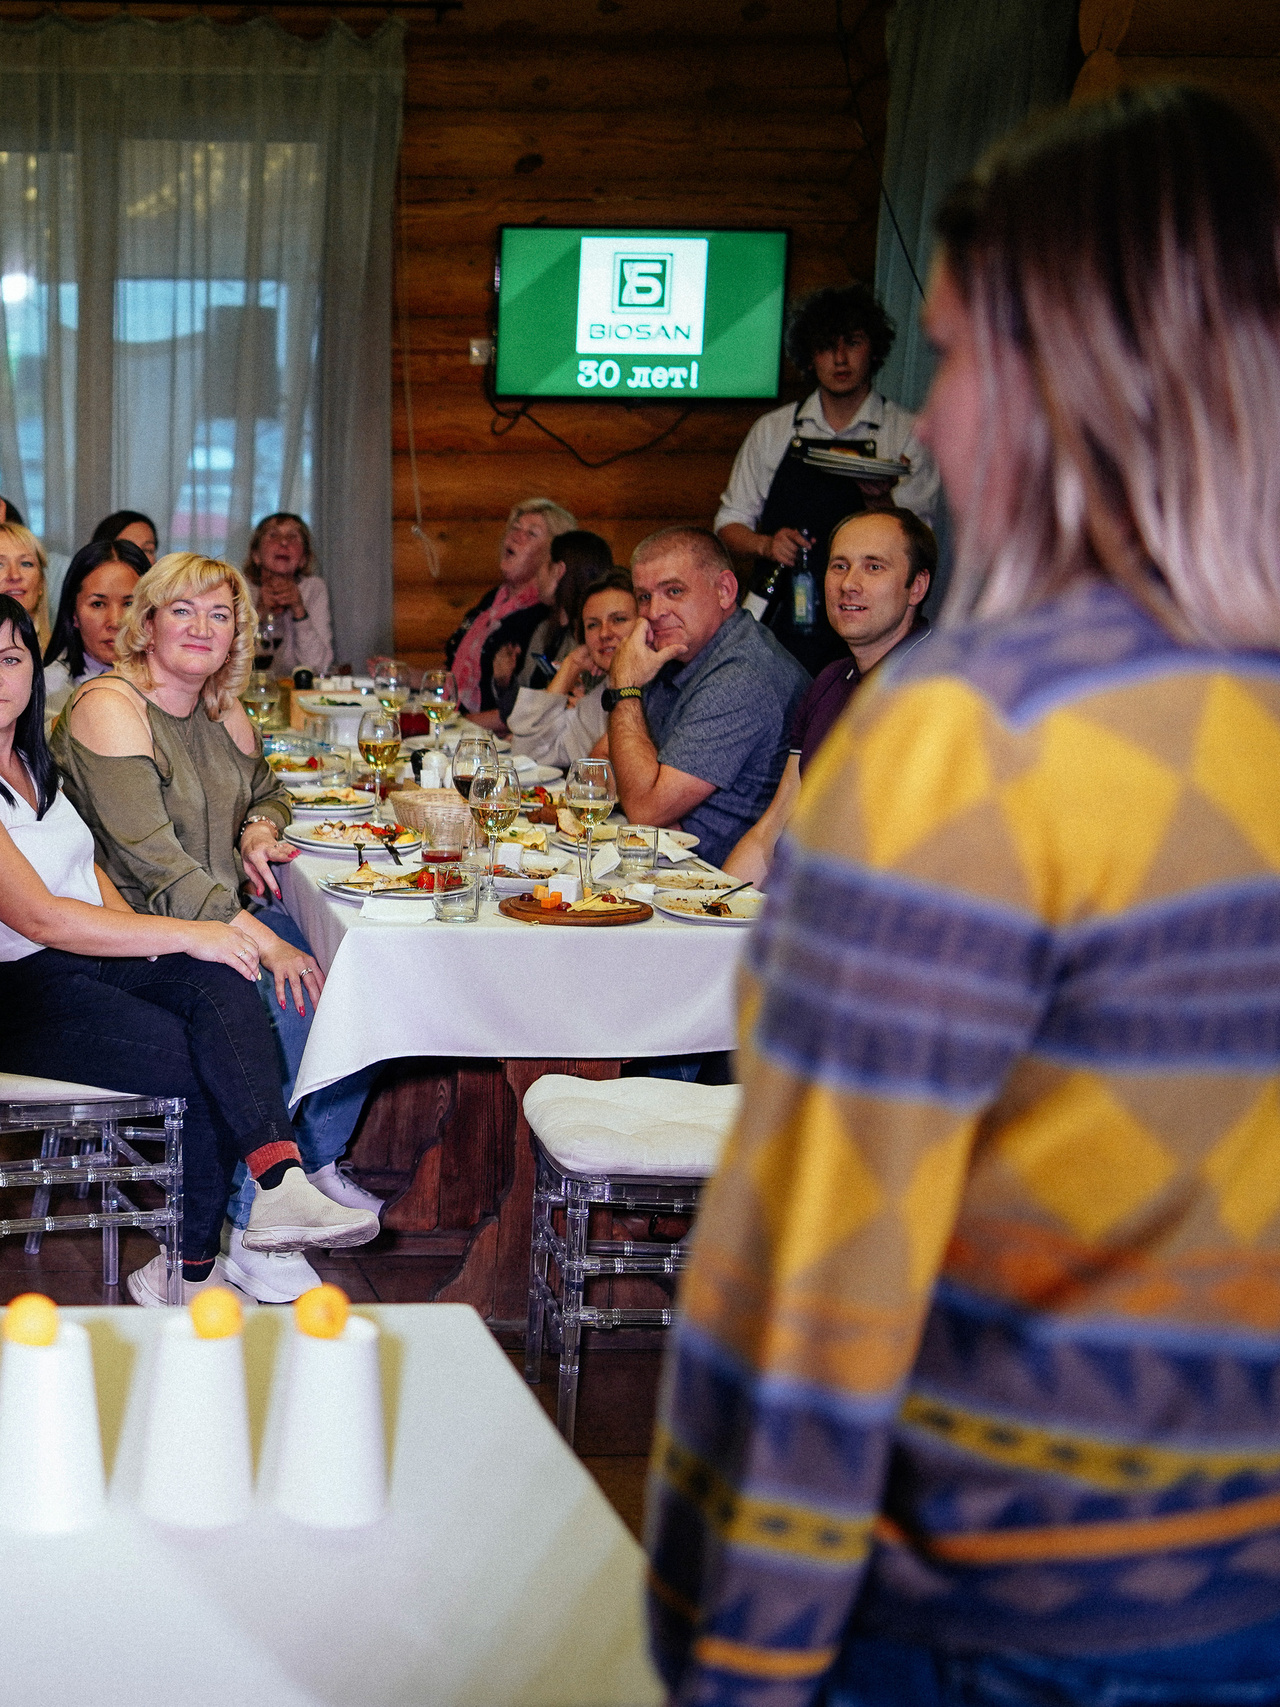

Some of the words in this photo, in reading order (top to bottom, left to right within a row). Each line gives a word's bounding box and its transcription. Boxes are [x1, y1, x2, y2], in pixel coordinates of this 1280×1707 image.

[589, 324, 691, 339] BIOSAN
[576, 359, 621, 389] 30
[626, 360, 699, 389] лет!
